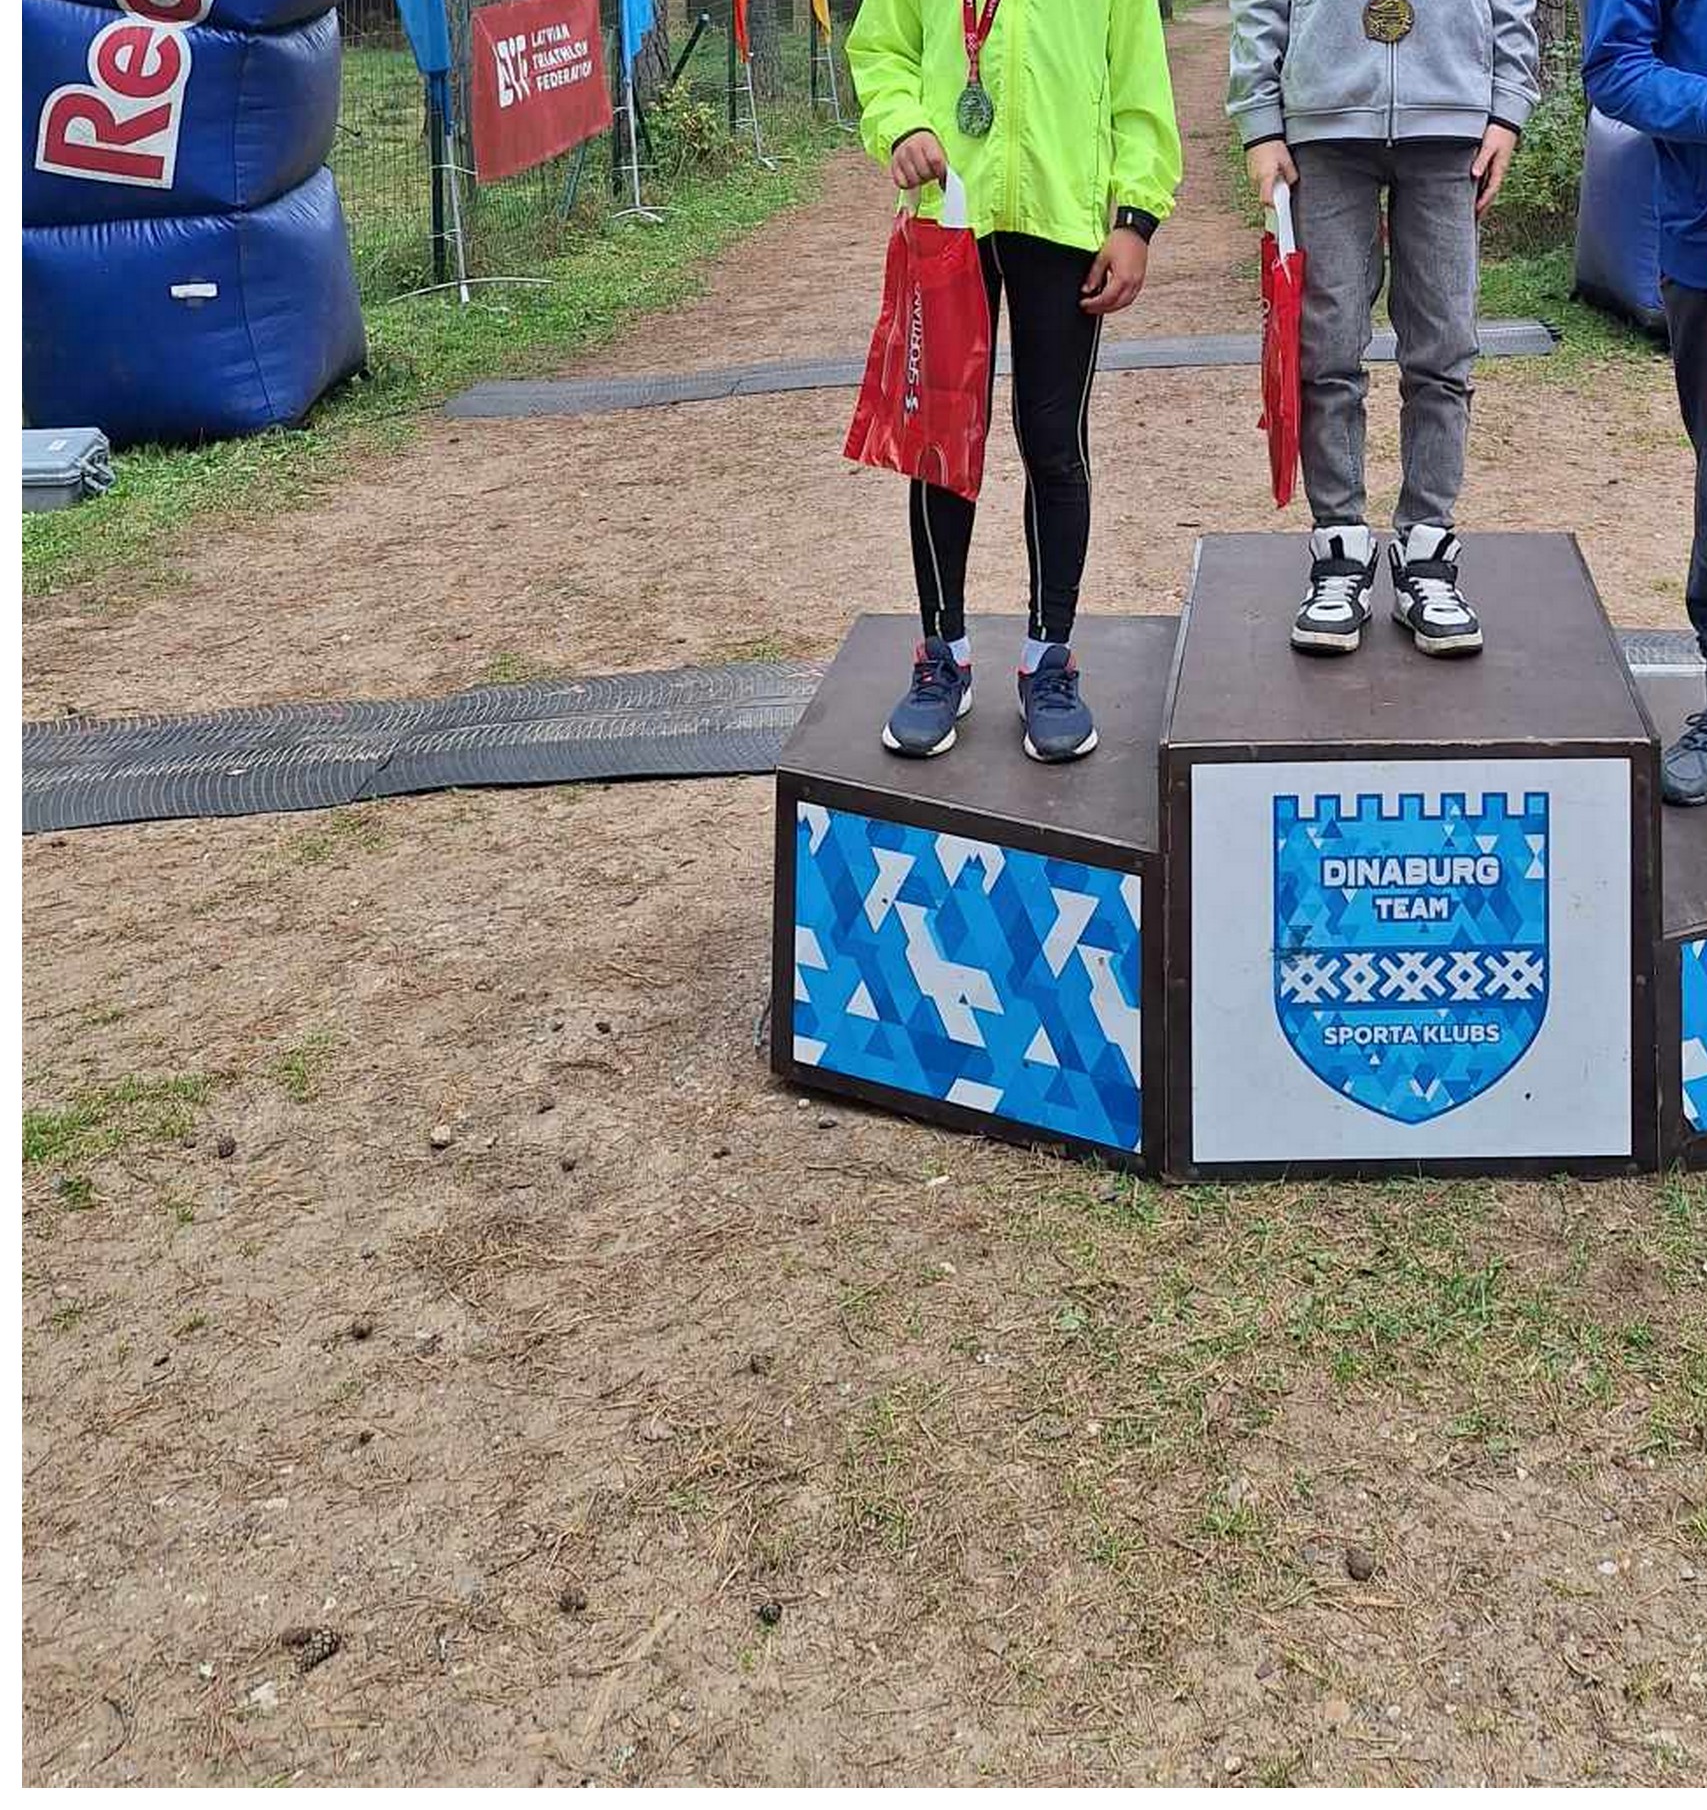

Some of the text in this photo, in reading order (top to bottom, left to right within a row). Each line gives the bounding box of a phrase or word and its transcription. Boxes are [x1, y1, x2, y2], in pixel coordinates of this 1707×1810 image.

[531, 23, 570, 48] LATVIAN
[532, 39, 588, 70] TRIATHLON
[1322, 856, 1501, 888] DINABURG
[1375, 896, 1450, 920] TEAM
[1324, 1025, 1500, 1045] SPORTA KLUBS
